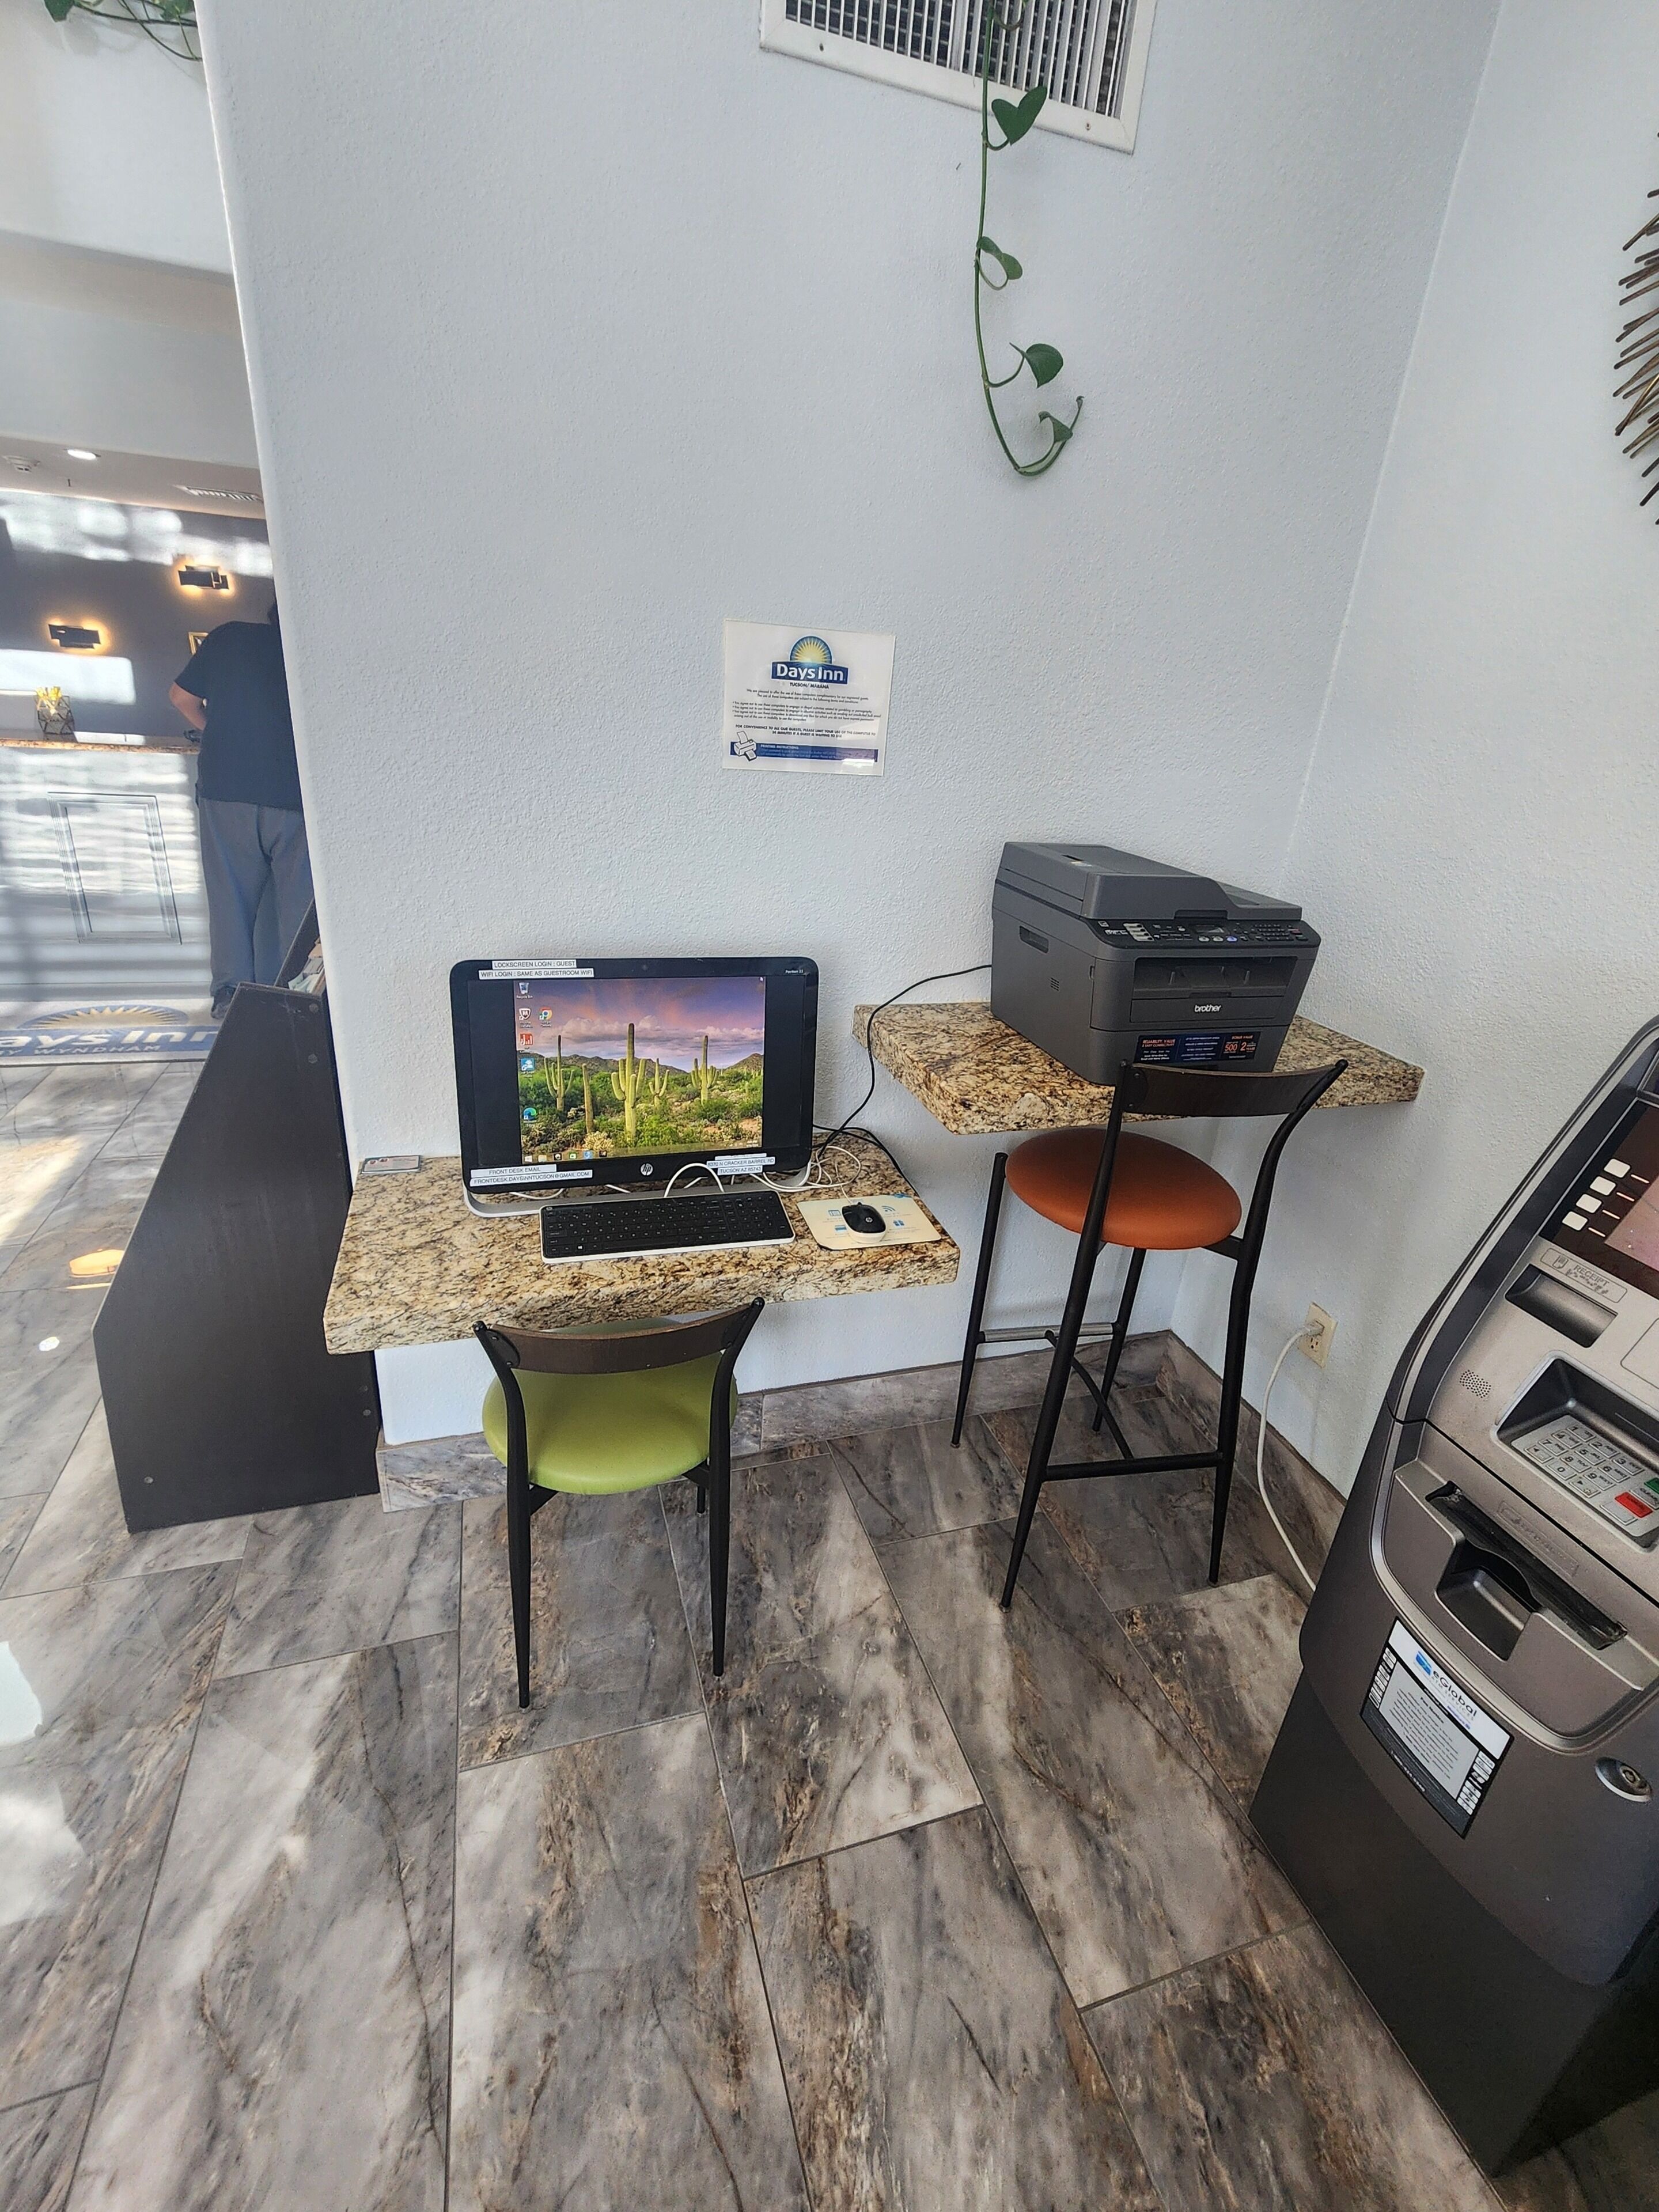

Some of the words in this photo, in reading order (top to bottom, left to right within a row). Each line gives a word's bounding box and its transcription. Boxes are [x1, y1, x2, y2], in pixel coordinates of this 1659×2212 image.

[777, 663, 816, 680] Days
[818, 667, 844, 681] Inn
[0, 1035, 112, 1048] ays
[1240, 1042, 1247, 1051] 2
[34, 1045, 160, 1055] WYNDHAM
[1574, 1264, 1609, 1287] RECEIPT
[1433, 1671, 1477, 1717] eGlobal
